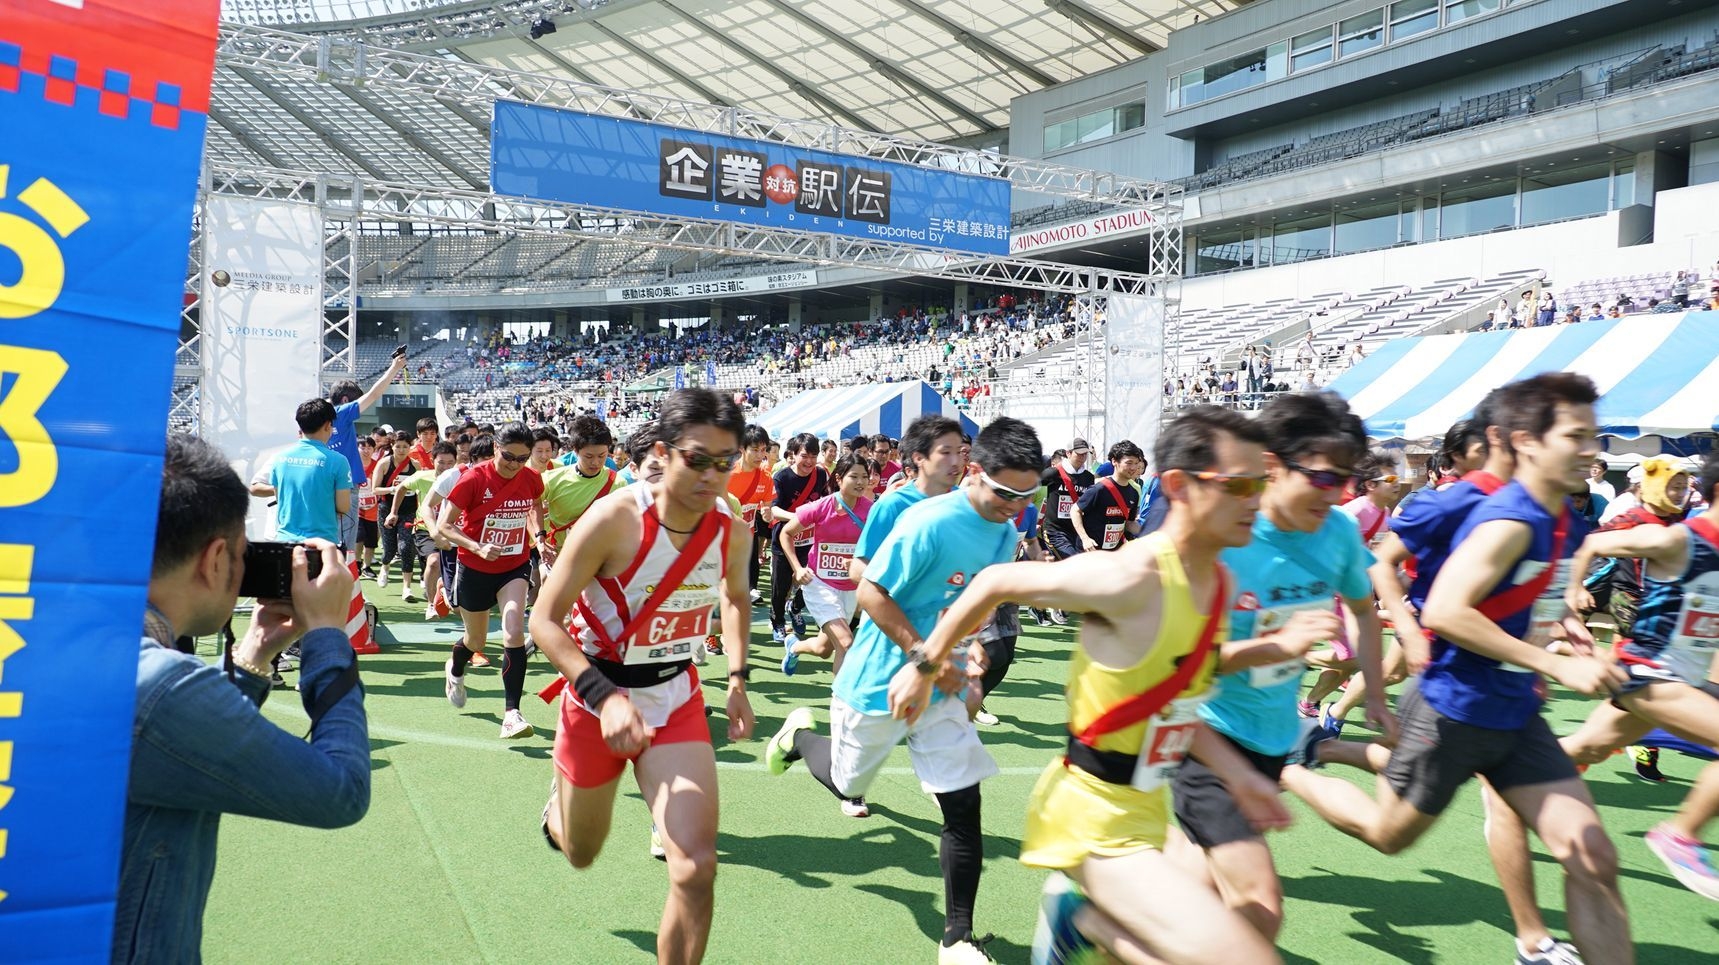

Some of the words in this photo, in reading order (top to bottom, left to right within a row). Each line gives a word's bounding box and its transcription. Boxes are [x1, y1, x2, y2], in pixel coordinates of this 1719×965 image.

[714, 204, 844, 228] EKIDEN
[867, 224, 925, 240] supported
[929, 230, 944, 244] by
[928, 217, 1010, 241] 三栄建築設計
[1010, 223, 1087, 251] AJINOMOTO
[1093, 209, 1156, 235] STADIUM
[264, 273, 292, 281] GROUP
[232, 279, 315, 296] 三栄建築設計
[227, 325, 300, 339] SPORTSONE
